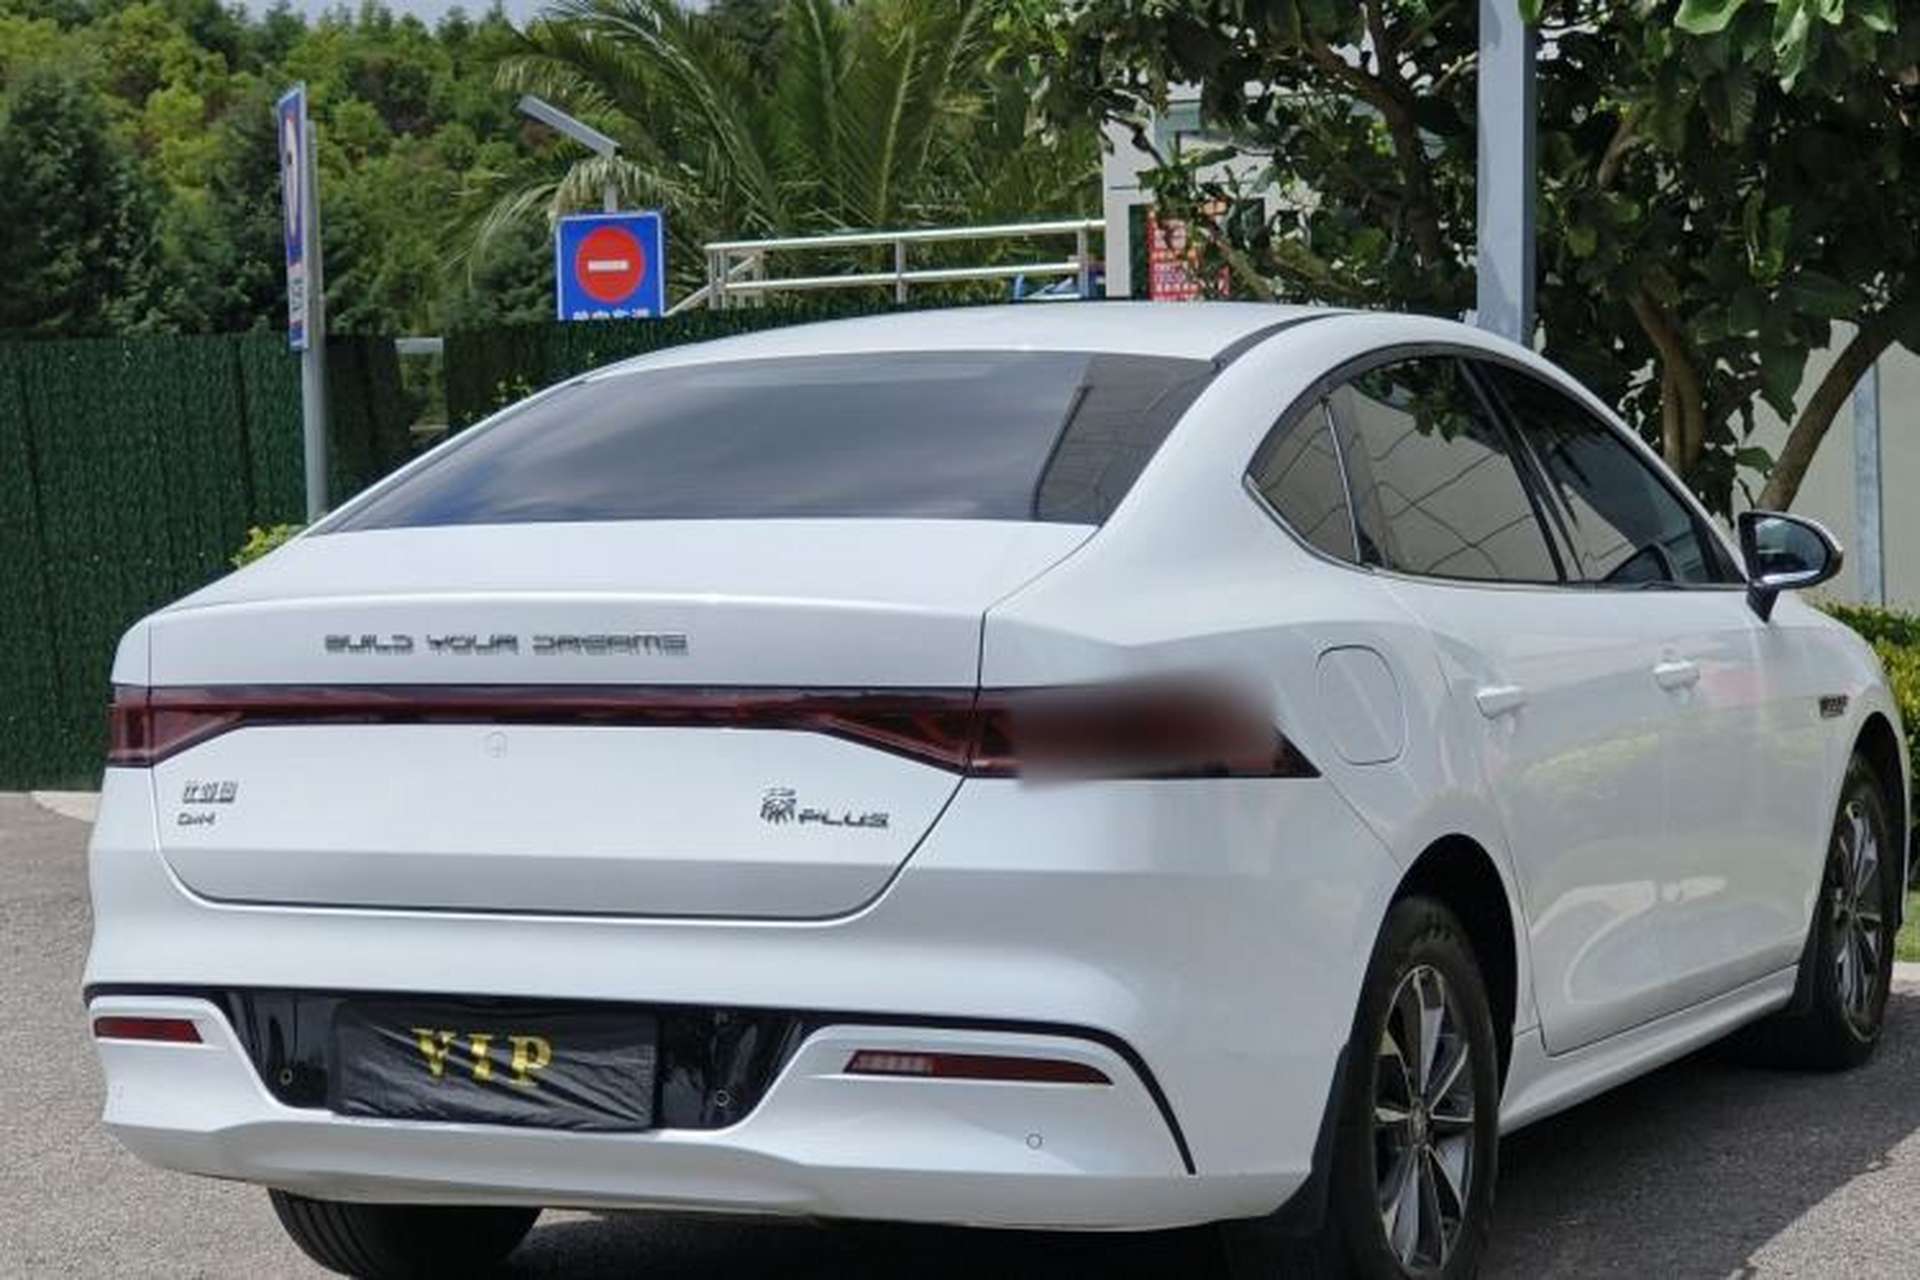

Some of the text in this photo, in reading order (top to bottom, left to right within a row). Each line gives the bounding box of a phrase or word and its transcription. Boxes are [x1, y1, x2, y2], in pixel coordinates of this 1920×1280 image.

[325, 634, 688, 655] BUILD YOUR DREAMS
[798, 808, 888, 828] PLUS
[410, 1029, 552, 1087] VIP
